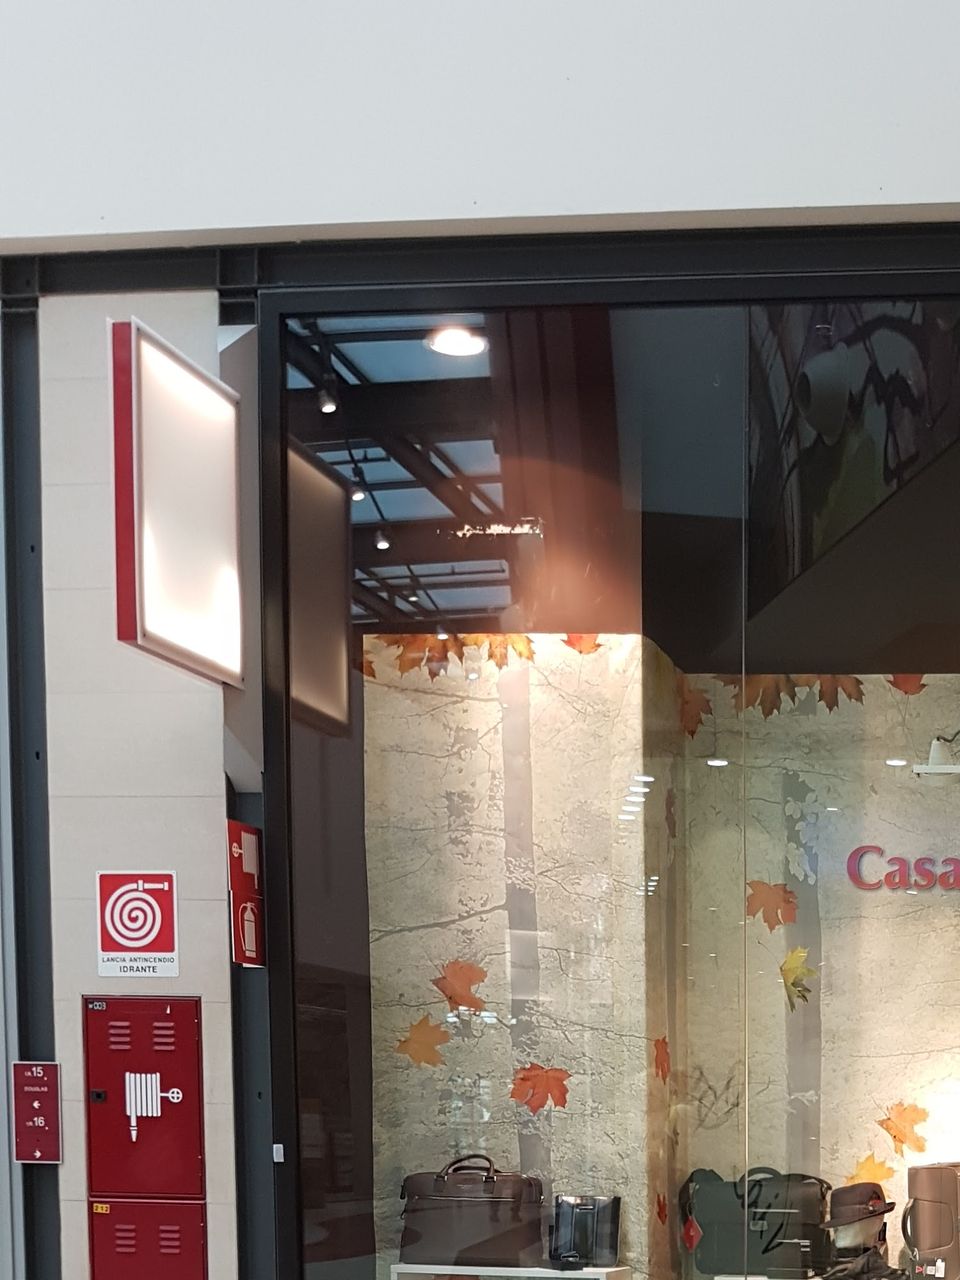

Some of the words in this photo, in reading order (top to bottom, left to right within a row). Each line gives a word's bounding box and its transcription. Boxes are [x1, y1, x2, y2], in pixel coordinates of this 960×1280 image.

[119, 965, 158, 974] IDRANTE
[32, 1066, 44, 1077] 15
[33, 1116, 45, 1126] 16
